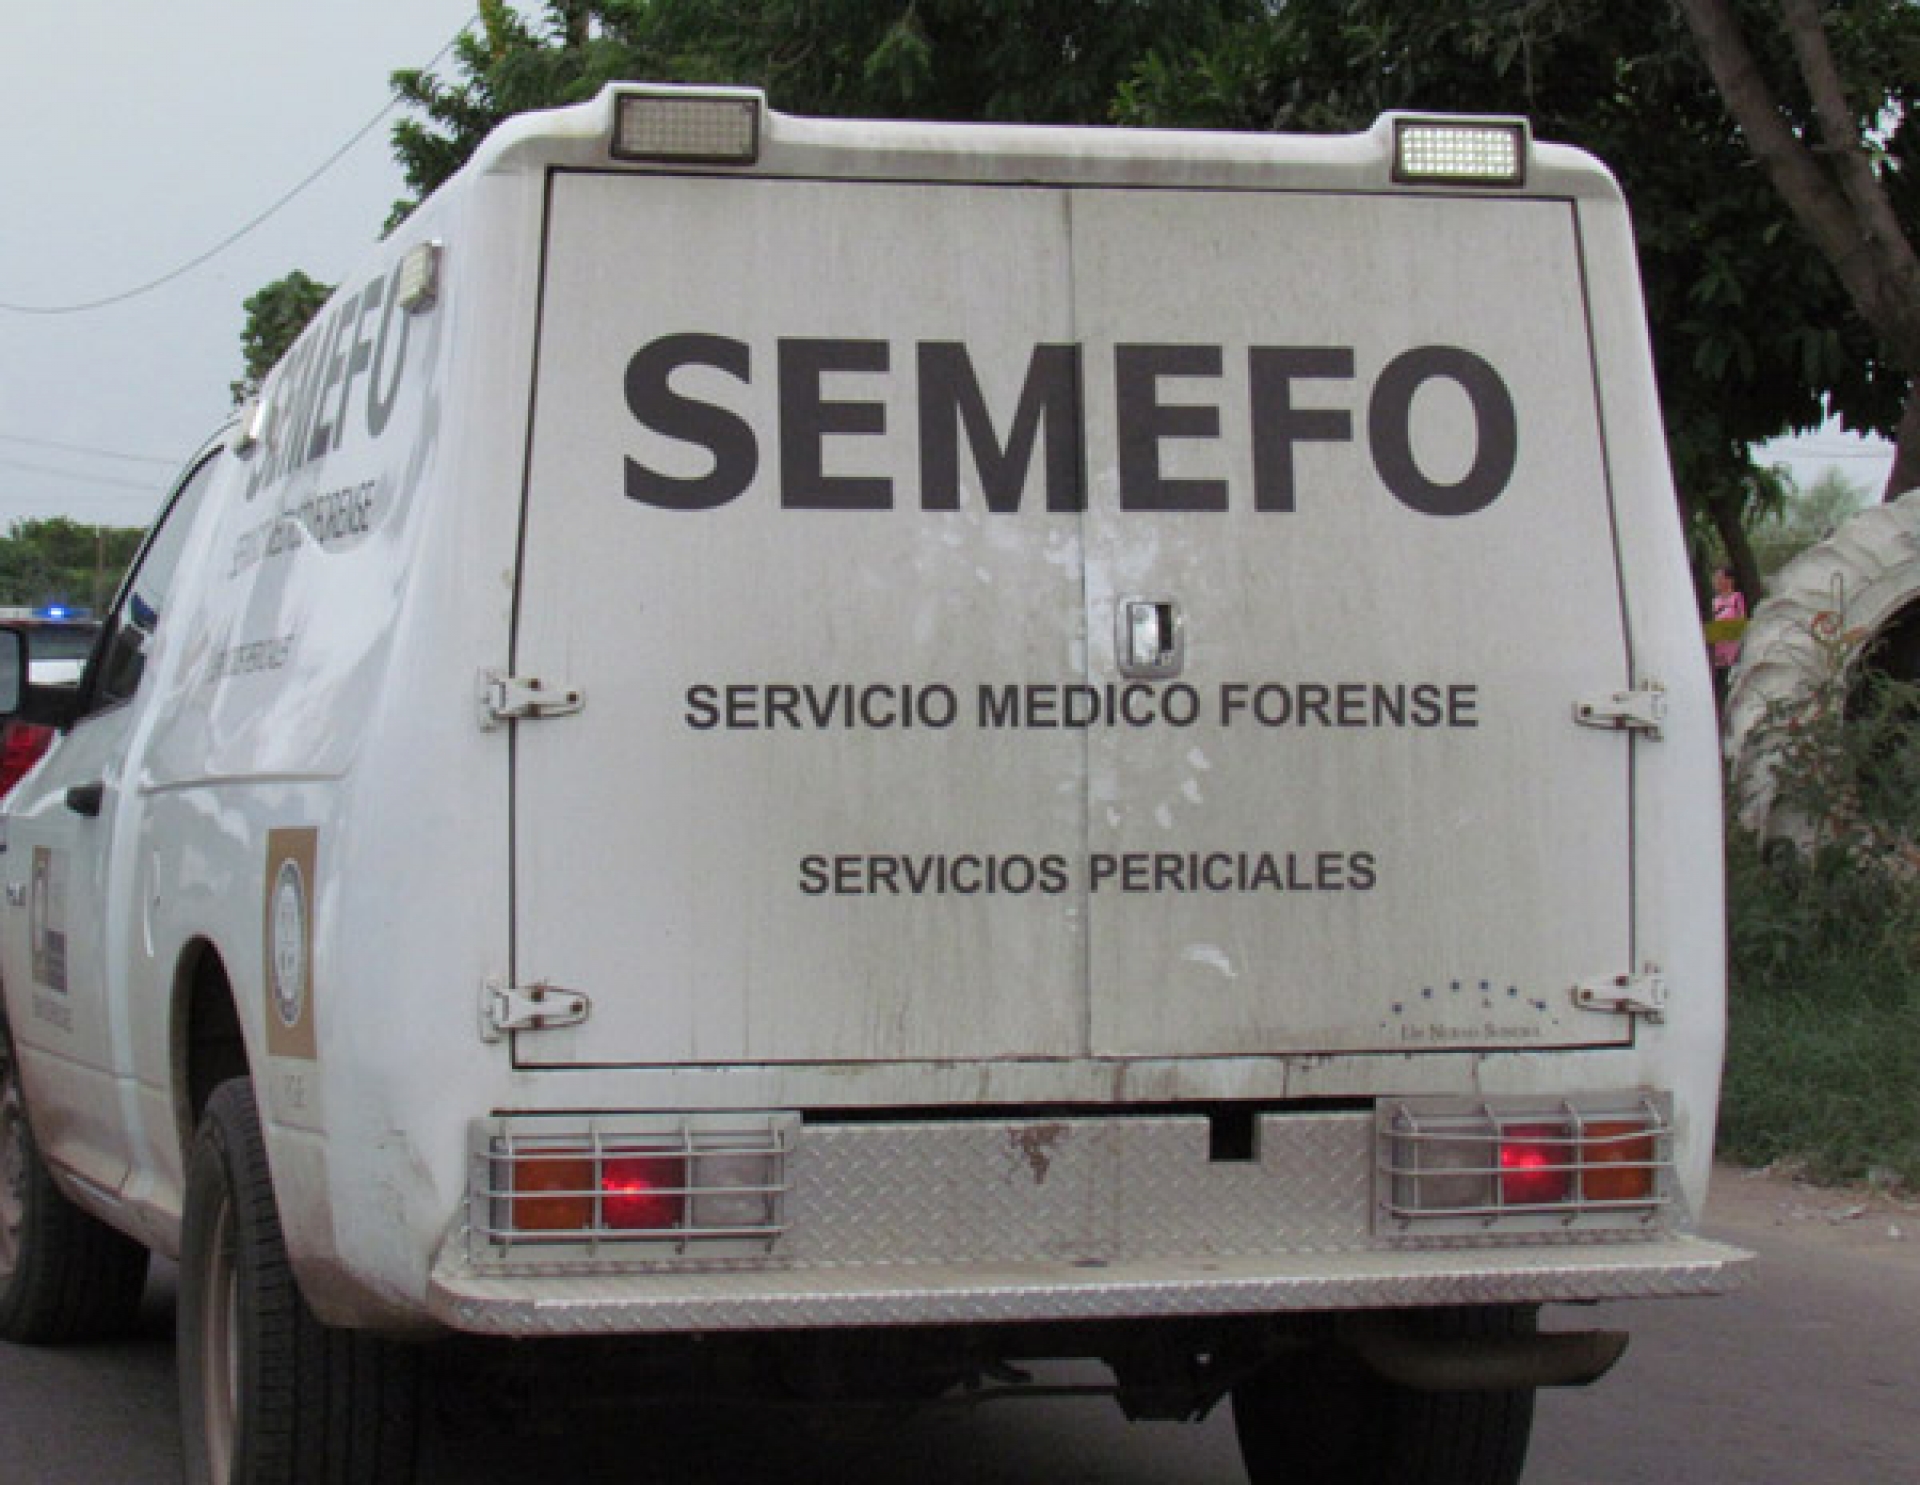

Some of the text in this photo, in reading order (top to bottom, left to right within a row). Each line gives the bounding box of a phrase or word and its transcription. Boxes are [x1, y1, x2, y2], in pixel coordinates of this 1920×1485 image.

[623, 332, 1518, 516] SEMEFO
[684, 681, 1479, 731] SERVICIO MEDICO FORENSE
[799, 850, 1377, 896] SERVICIOS PERICIALES
